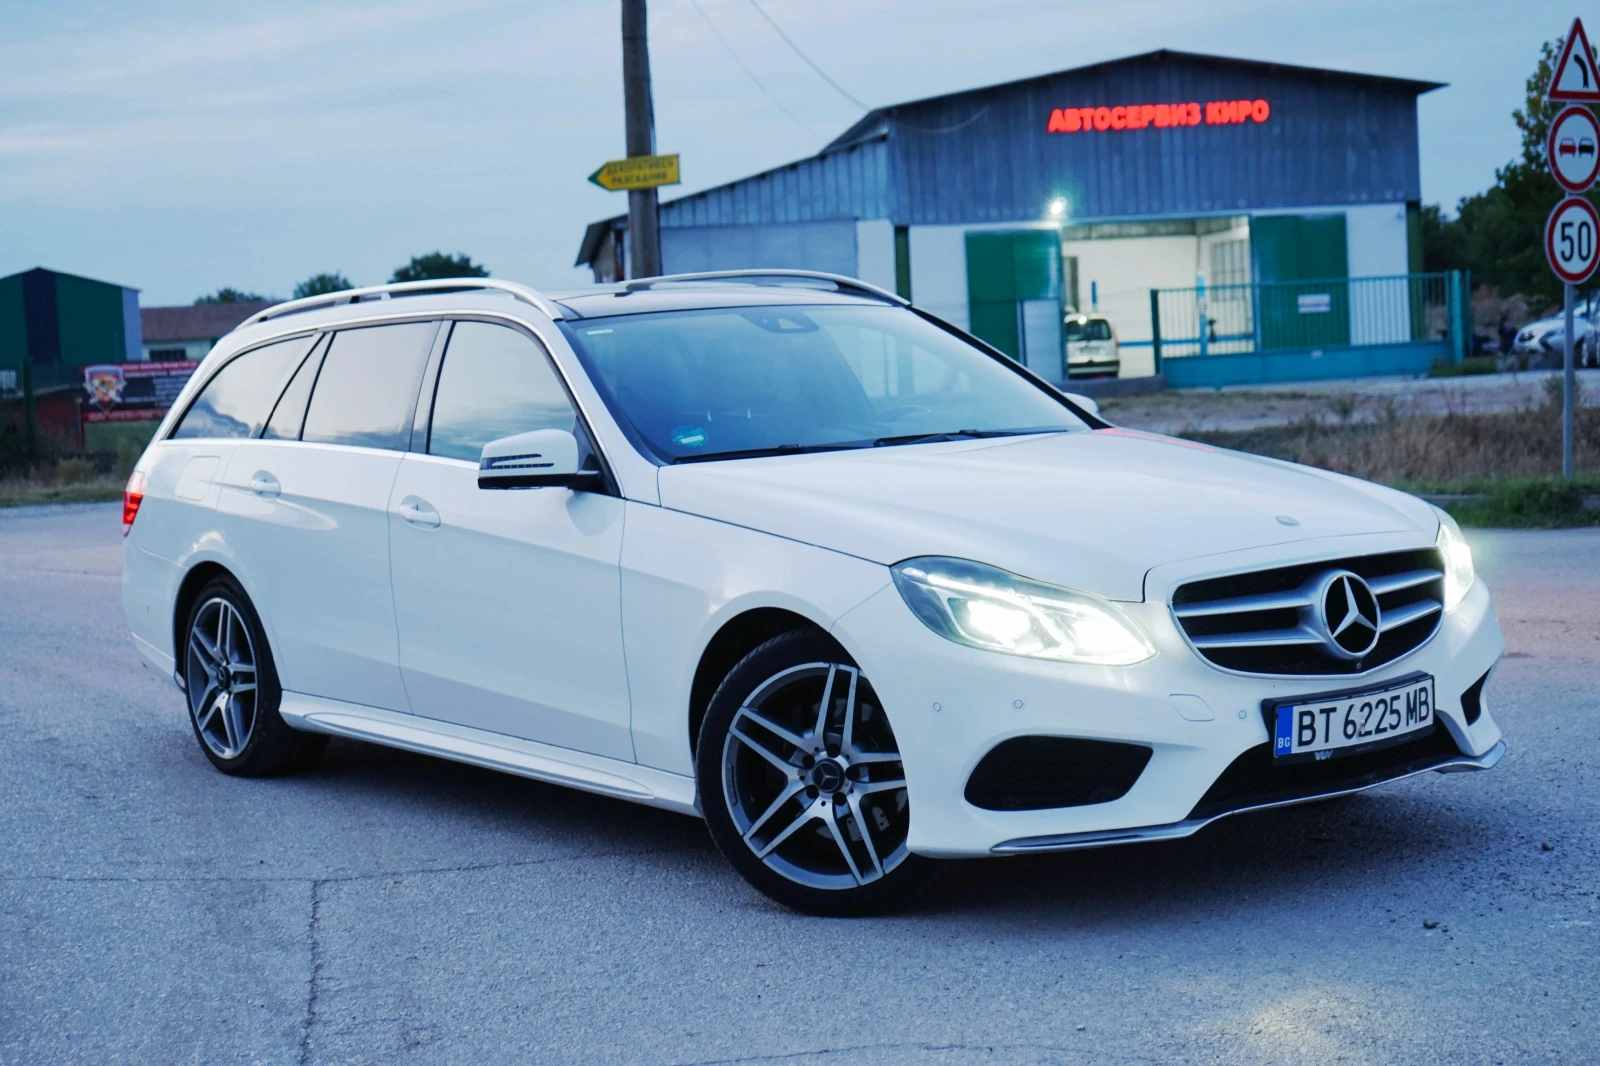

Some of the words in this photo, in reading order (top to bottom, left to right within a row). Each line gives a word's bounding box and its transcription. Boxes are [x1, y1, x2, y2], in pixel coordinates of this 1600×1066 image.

[1048, 103, 1201, 133] АВТОСЕРВИЗ
[1206, 99, 1270, 124] КИРО
[1561, 221, 1592, 262] 50
[1298, 708, 1337, 747] BT
[1343, 695, 1401, 740] 6225
[1406, 686, 1430, 727] MB
[1277, 737, 1291, 749] BG
